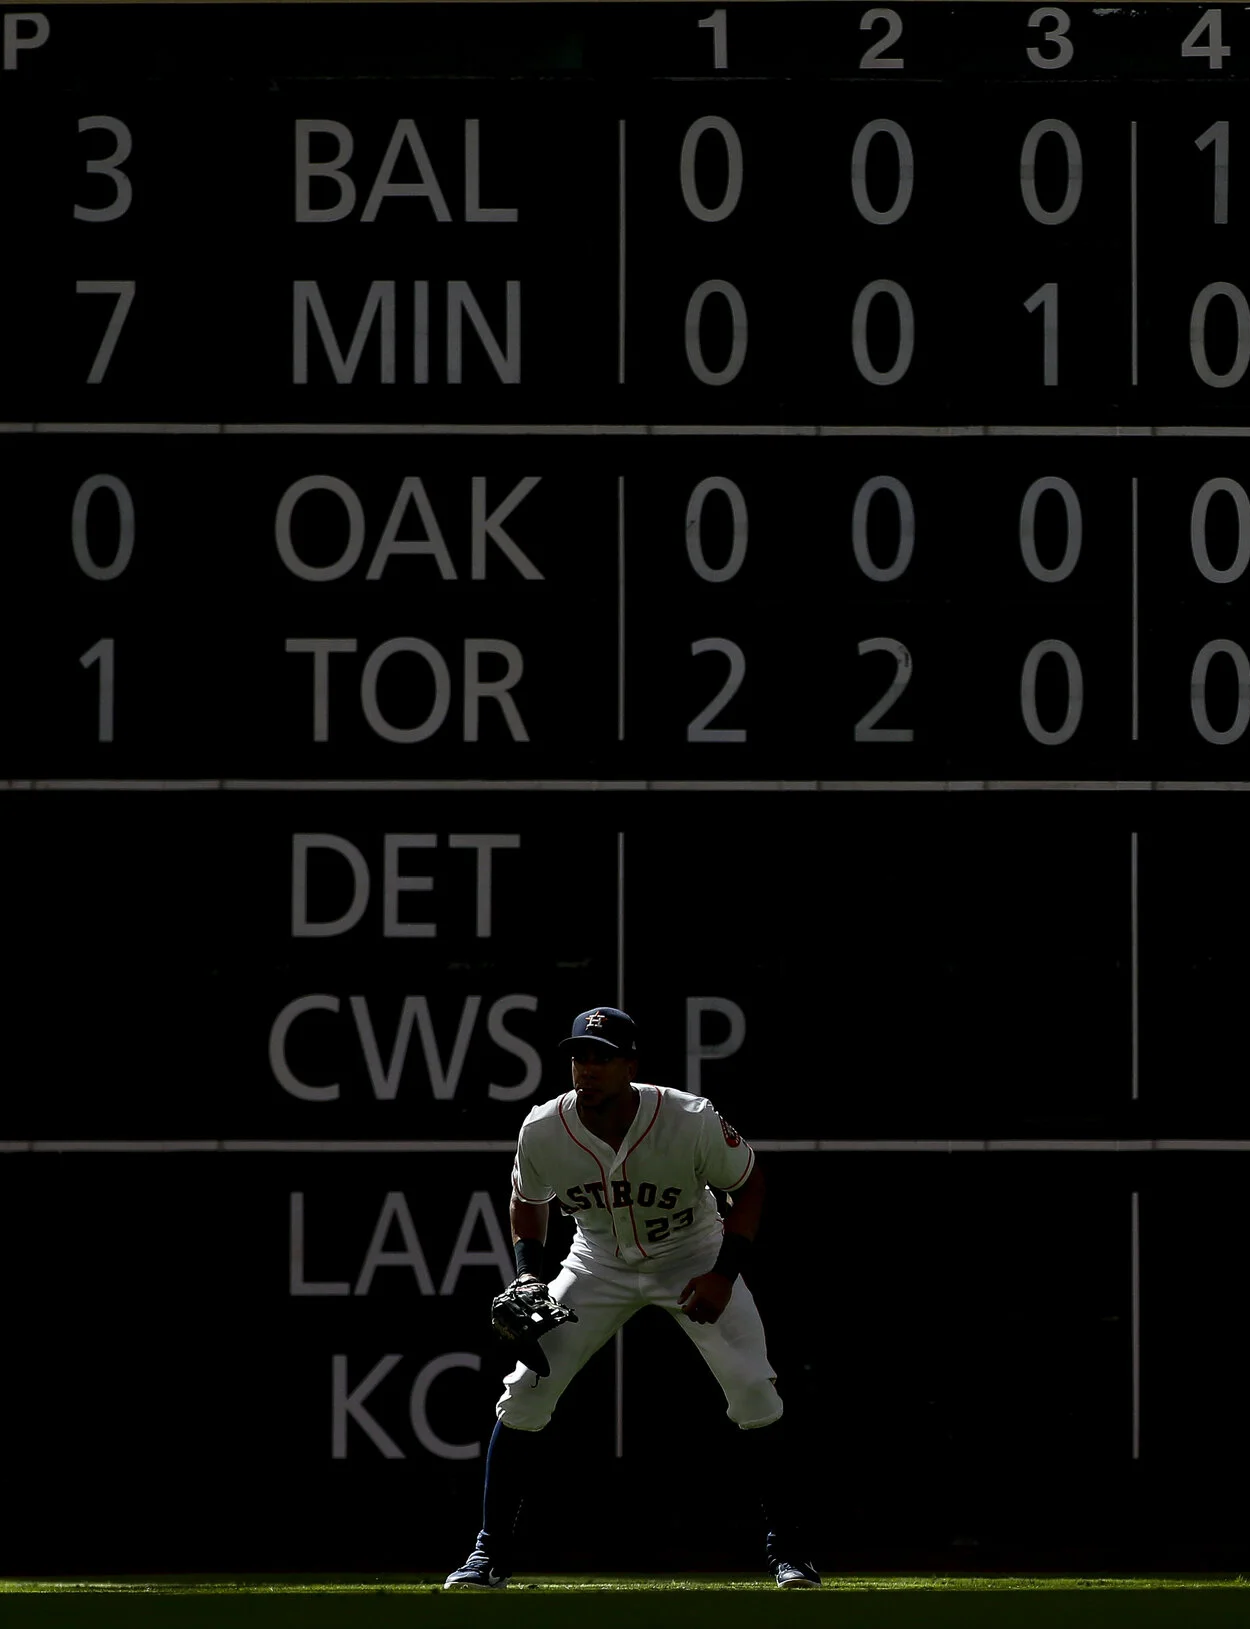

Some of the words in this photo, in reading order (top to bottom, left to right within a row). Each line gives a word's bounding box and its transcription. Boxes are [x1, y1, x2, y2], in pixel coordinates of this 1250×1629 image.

[3, 12, 50, 70] P
[698, 9, 728, 69] 1
[859, 7, 905, 69] 2
[1026, 6, 1074, 70] 3
[1181, 8, 1231, 70] 4
[73, 115, 132, 222] 3
[295, 118, 518, 223] BAL
[680, 115, 743, 223] 0
[851, 118, 914, 225] 0
[1020, 118, 1083, 226] 0
[1194, 120, 1229, 225] 1
[76, 280, 136, 384] 7
[293, 280, 521, 384] MIN
[685, 279, 748, 386] 0
[852, 279, 914, 386] 0
[1023, 282, 1058, 386] 1
[72, 474, 134, 580] 0
[275, 474, 545, 582] OAK
[685, 476, 748, 583] 0
[852, 475, 915, 582] 0
[1019, 476, 1083, 583] 0
[79, 639, 114, 741] 1
[285, 637, 530, 743] TOR
[687, 637, 747, 743] 2
[855, 637, 913, 742] 2
[1020, 639, 1083, 745] 0
[292, 833, 520, 938] DET
[269, 994, 542, 1101] CWS
[685, 996, 747, 1097] P
[288, 1190, 517, 1297] LAA
[645, 1208, 694, 1242] 23
[331, 1353, 483, 1460] KC
